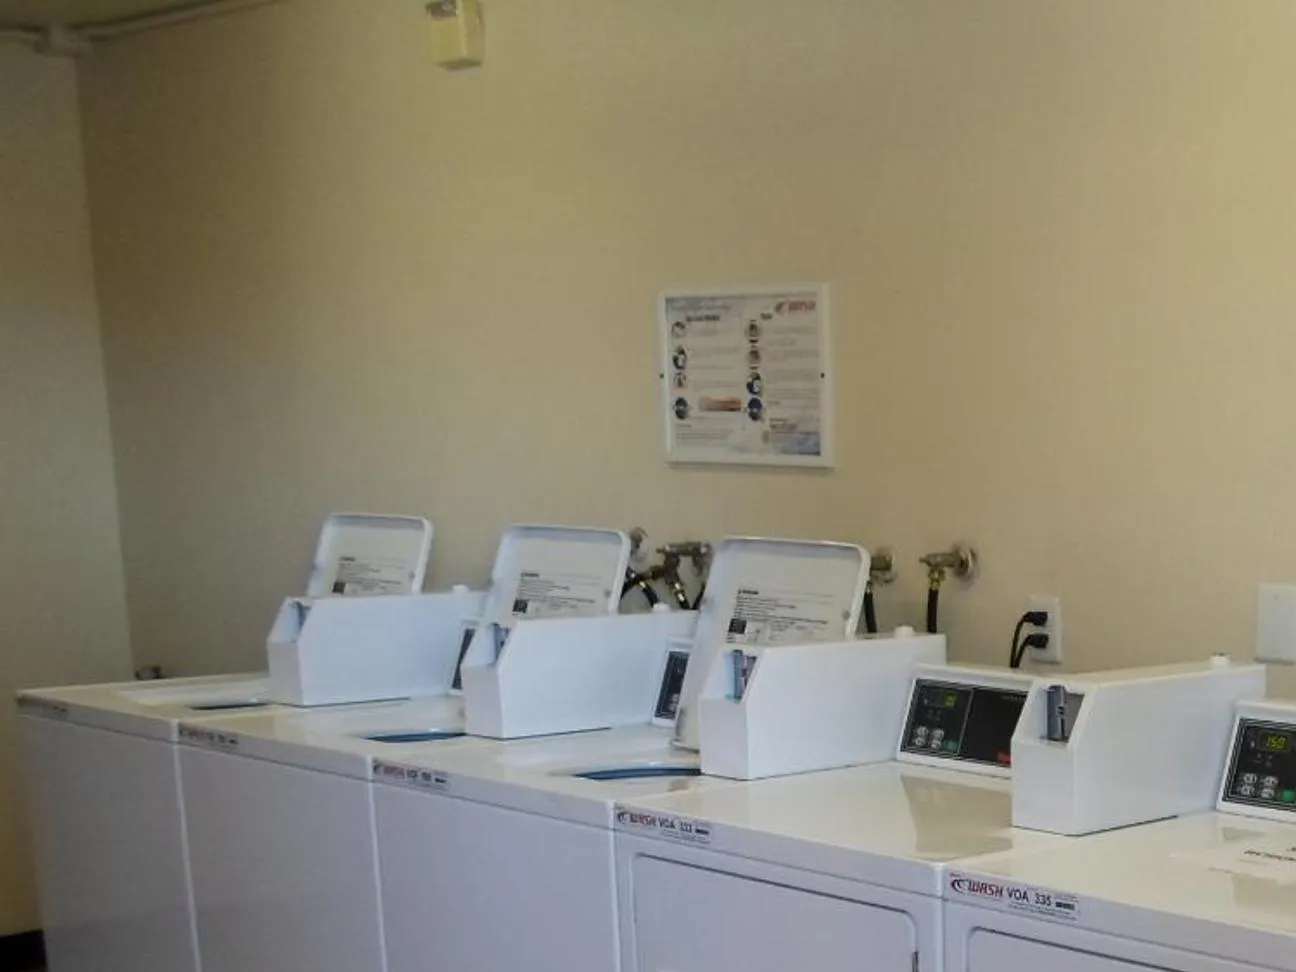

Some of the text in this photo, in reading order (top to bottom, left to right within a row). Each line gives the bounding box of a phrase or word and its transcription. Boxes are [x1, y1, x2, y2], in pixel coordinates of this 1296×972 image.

[967, 880, 1052, 906] WASH VOA 335
